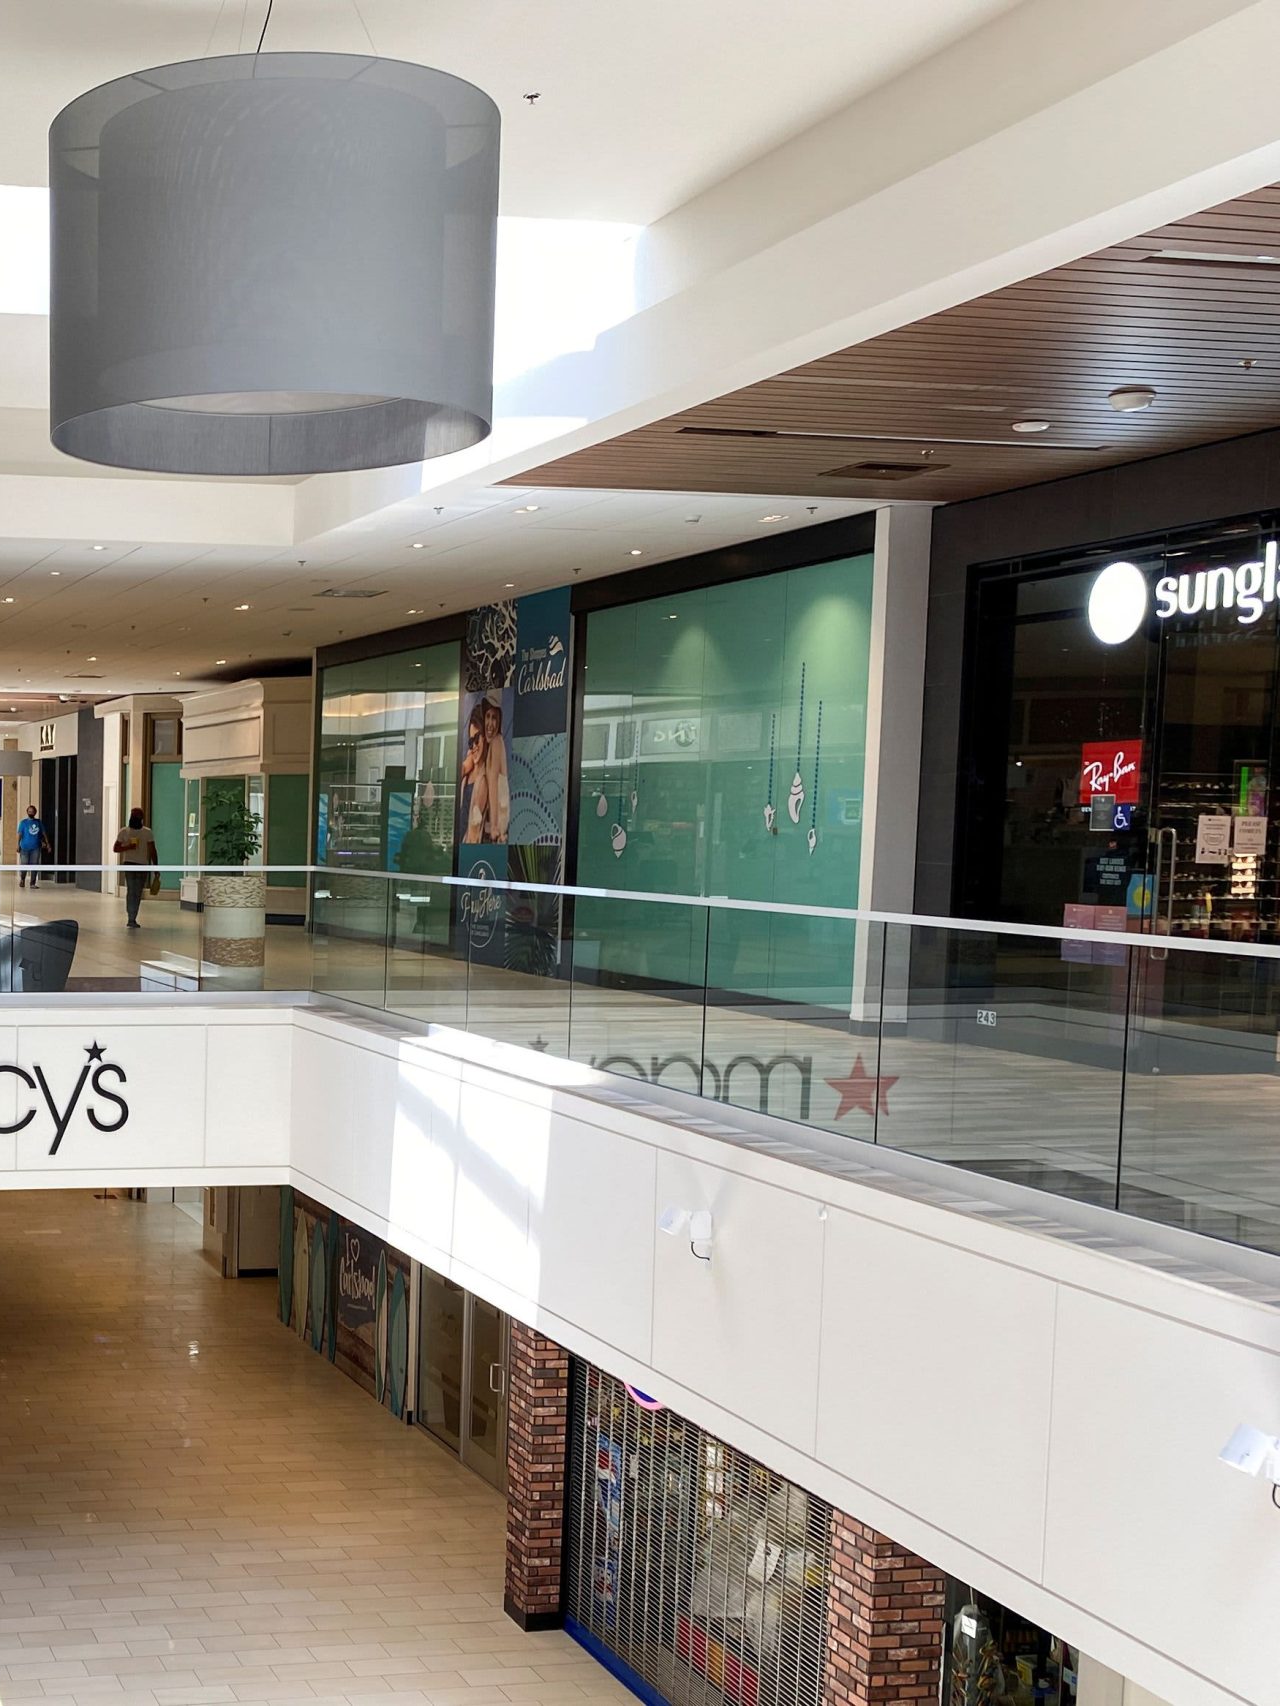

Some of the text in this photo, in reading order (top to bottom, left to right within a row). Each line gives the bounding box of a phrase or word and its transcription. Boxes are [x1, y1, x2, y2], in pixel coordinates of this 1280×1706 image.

[1155, 541, 1280, 624] sungl
[518, 657, 566, 695] Carlsbad
[977, 1011, 996, 1025] 243
[340, 1257, 376, 1311] Carlsbad
